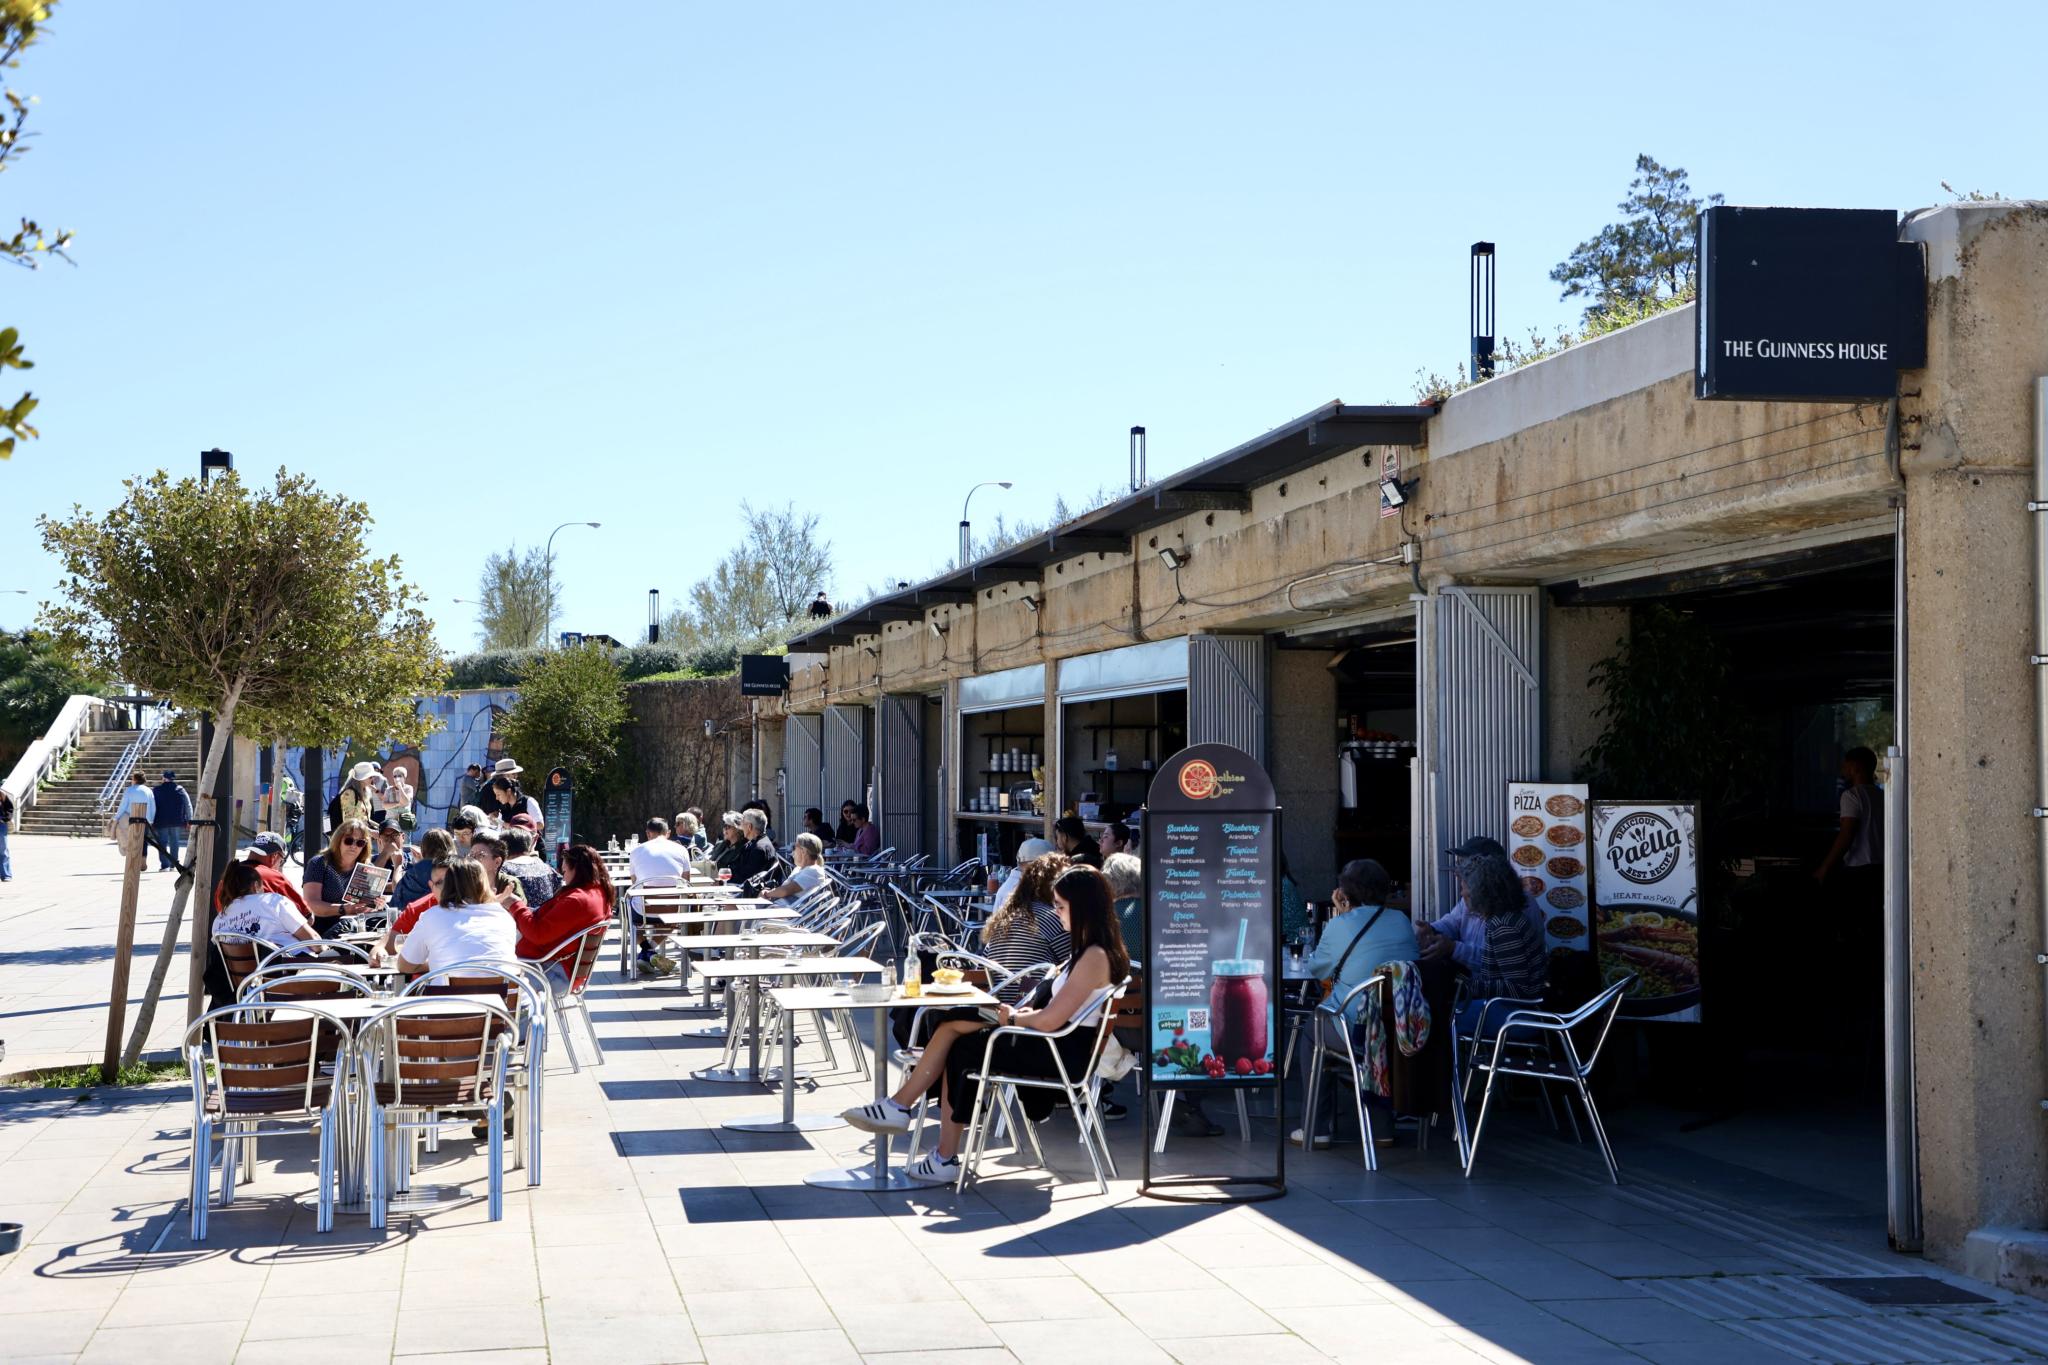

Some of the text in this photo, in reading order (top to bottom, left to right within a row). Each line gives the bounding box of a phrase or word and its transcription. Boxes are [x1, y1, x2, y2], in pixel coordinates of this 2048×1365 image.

[1724, 339, 1888, 360] THE GUINNESS HOUSE
[1514, 796, 1542, 811] PIZZA
[1166, 824, 1200, 834] Sunshine
[1222, 823, 1260, 835] Blueberry
[1615, 817, 1656, 840] DELICIOUS
[1171, 846, 1195, 856] Sunset
[1226, 845, 1258, 857] Tropical
[1606, 828, 1682, 871] Paella
[1626, 851, 1673, 879] BEST RECIPE
[1226, 868, 1256, 879] Fantasy
[1613, 892, 1643, 900] HEART
[1173, 911, 1195, 922] Green
